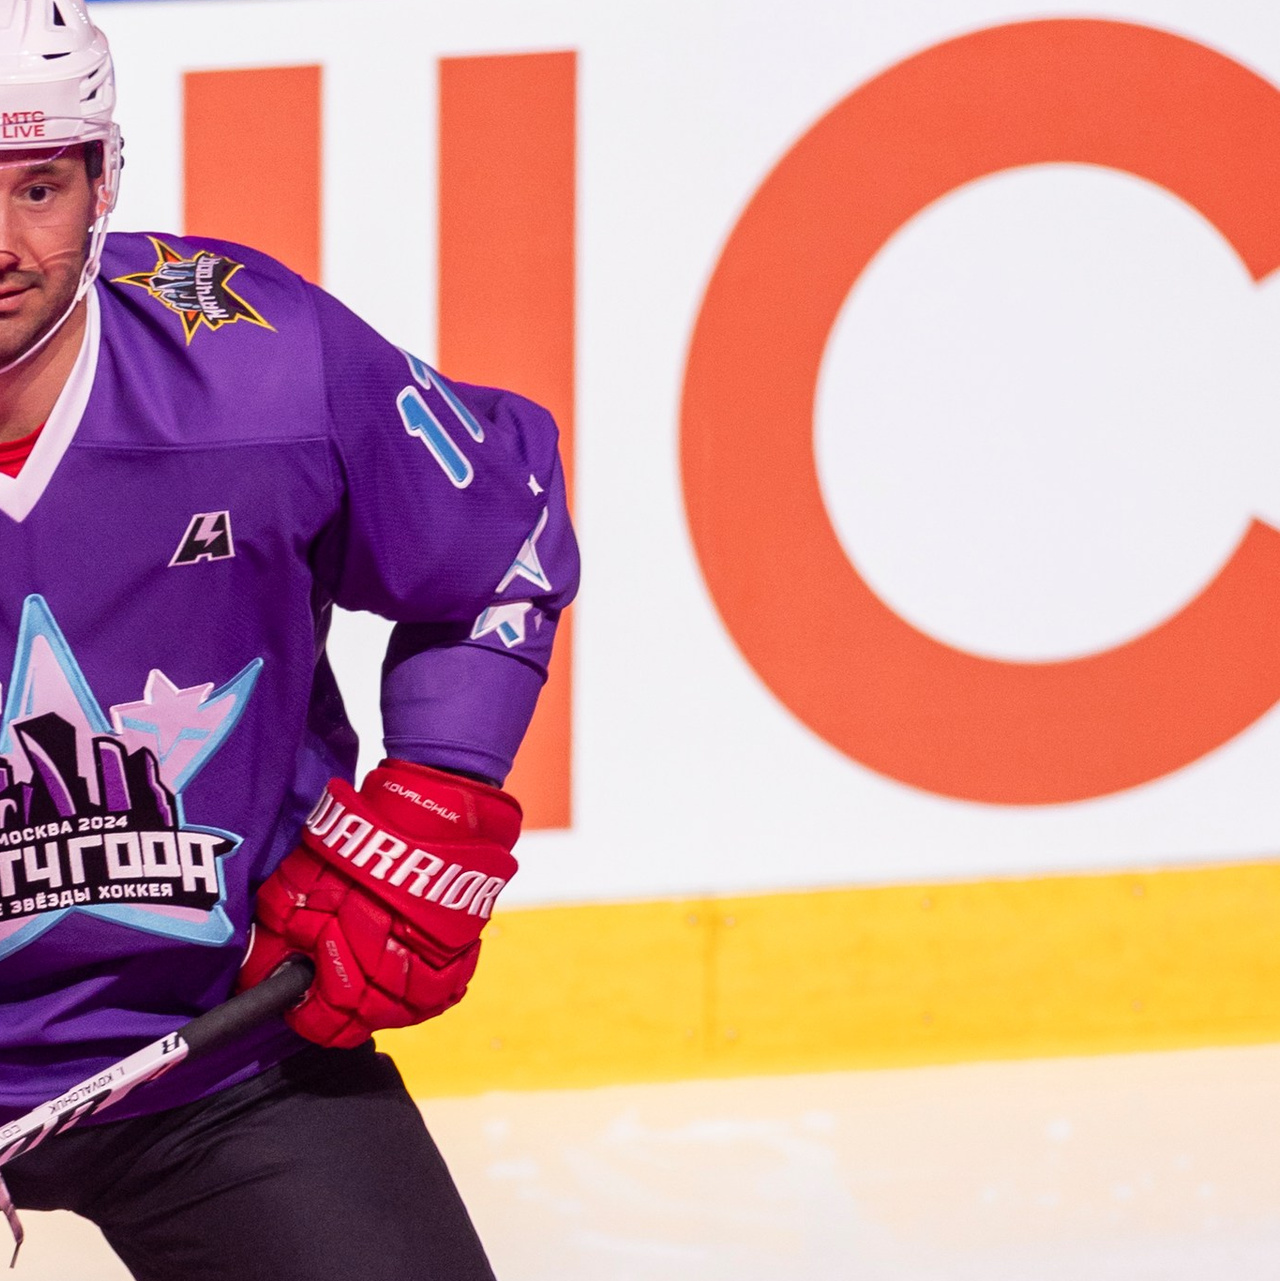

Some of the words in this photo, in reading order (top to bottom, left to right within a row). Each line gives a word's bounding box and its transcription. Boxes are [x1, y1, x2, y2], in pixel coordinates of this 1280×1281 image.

[2, 124, 45, 138] LIVE
[382, 780, 461, 824] KOVALCHUK
[78, 815, 128, 832] 2024
[9, 889, 91, 915] ЗВЁЗДЫ
[98, 883, 173, 901] ХОККЕЯ
[48, 1073, 115, 1116] KOVALCHUK
